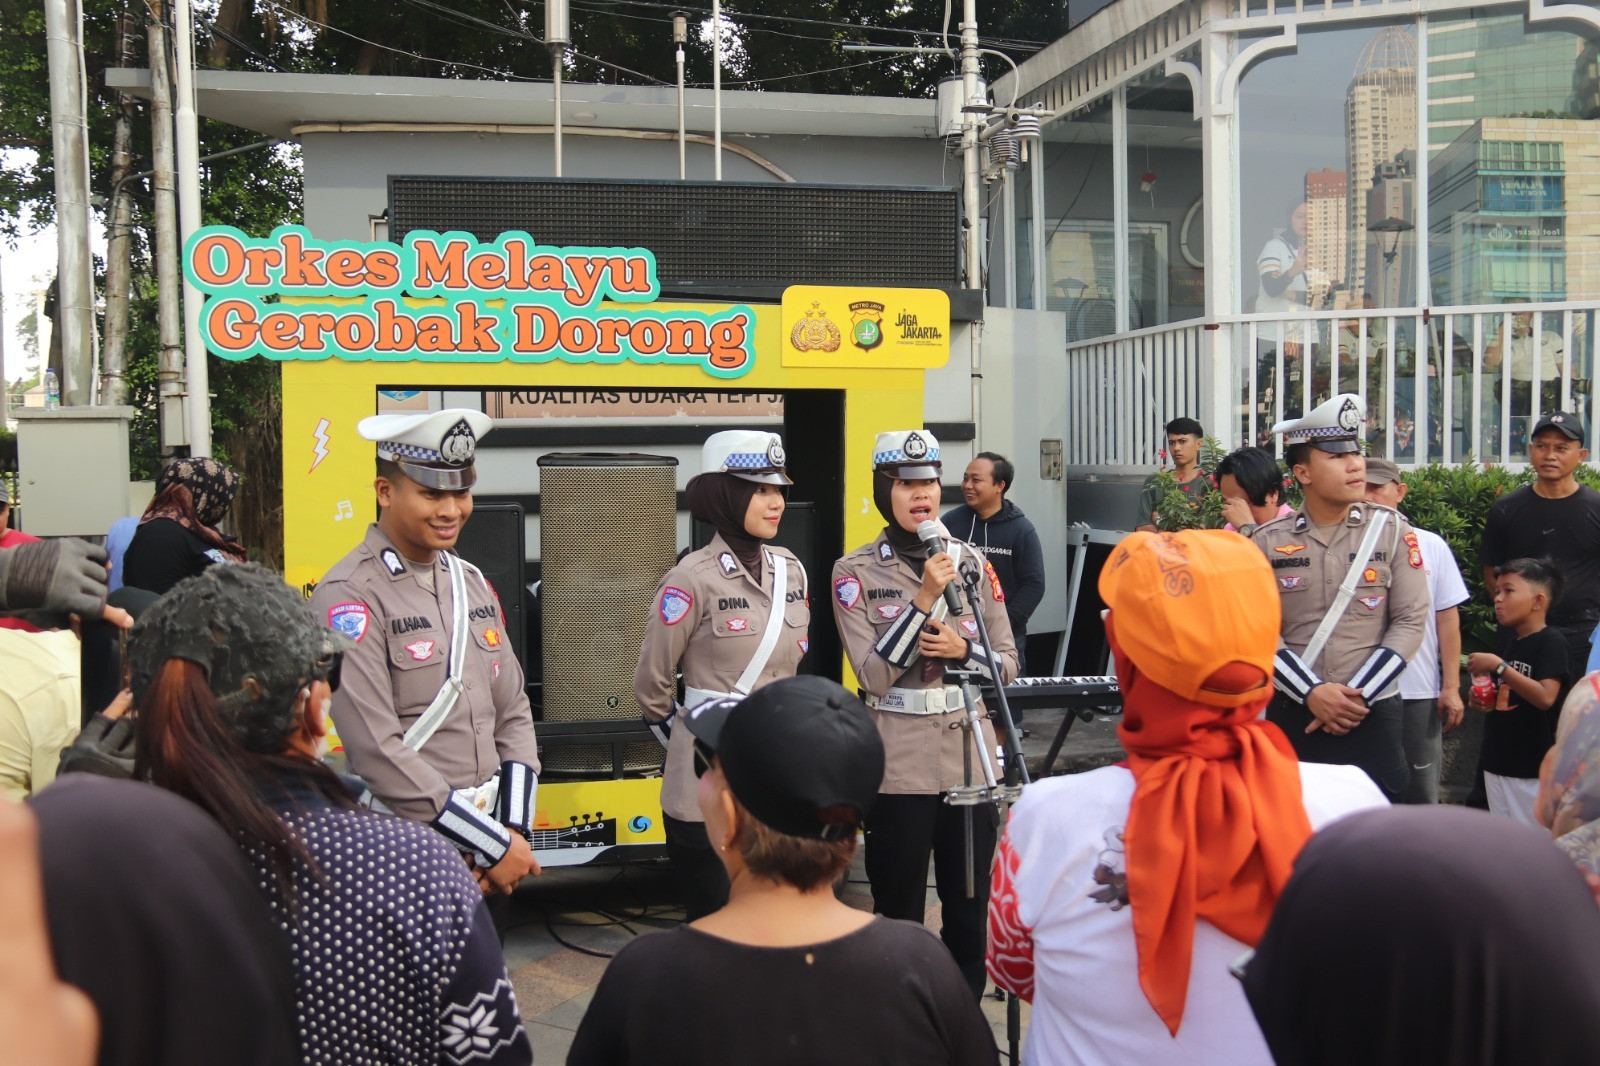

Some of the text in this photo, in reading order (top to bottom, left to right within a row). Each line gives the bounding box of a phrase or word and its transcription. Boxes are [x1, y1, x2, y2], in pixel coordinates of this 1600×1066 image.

[192, 234, 651, 306] Orkes Melayu
[851, 302, 869, 310] METRO
[895, 311, 918, 326] JAGA
[208, 300, 748, 369] Gerobak Dorong
[509, 391, 621, 404] KUALITAS
[629, 392, 707, 404] UDARA
[717, 393, 760, 403] TEPI
[867, 588, 903, 600] WINDY
[718, 597, 750, 611] DINA
[392, 616, 433, 635] ILHAM
